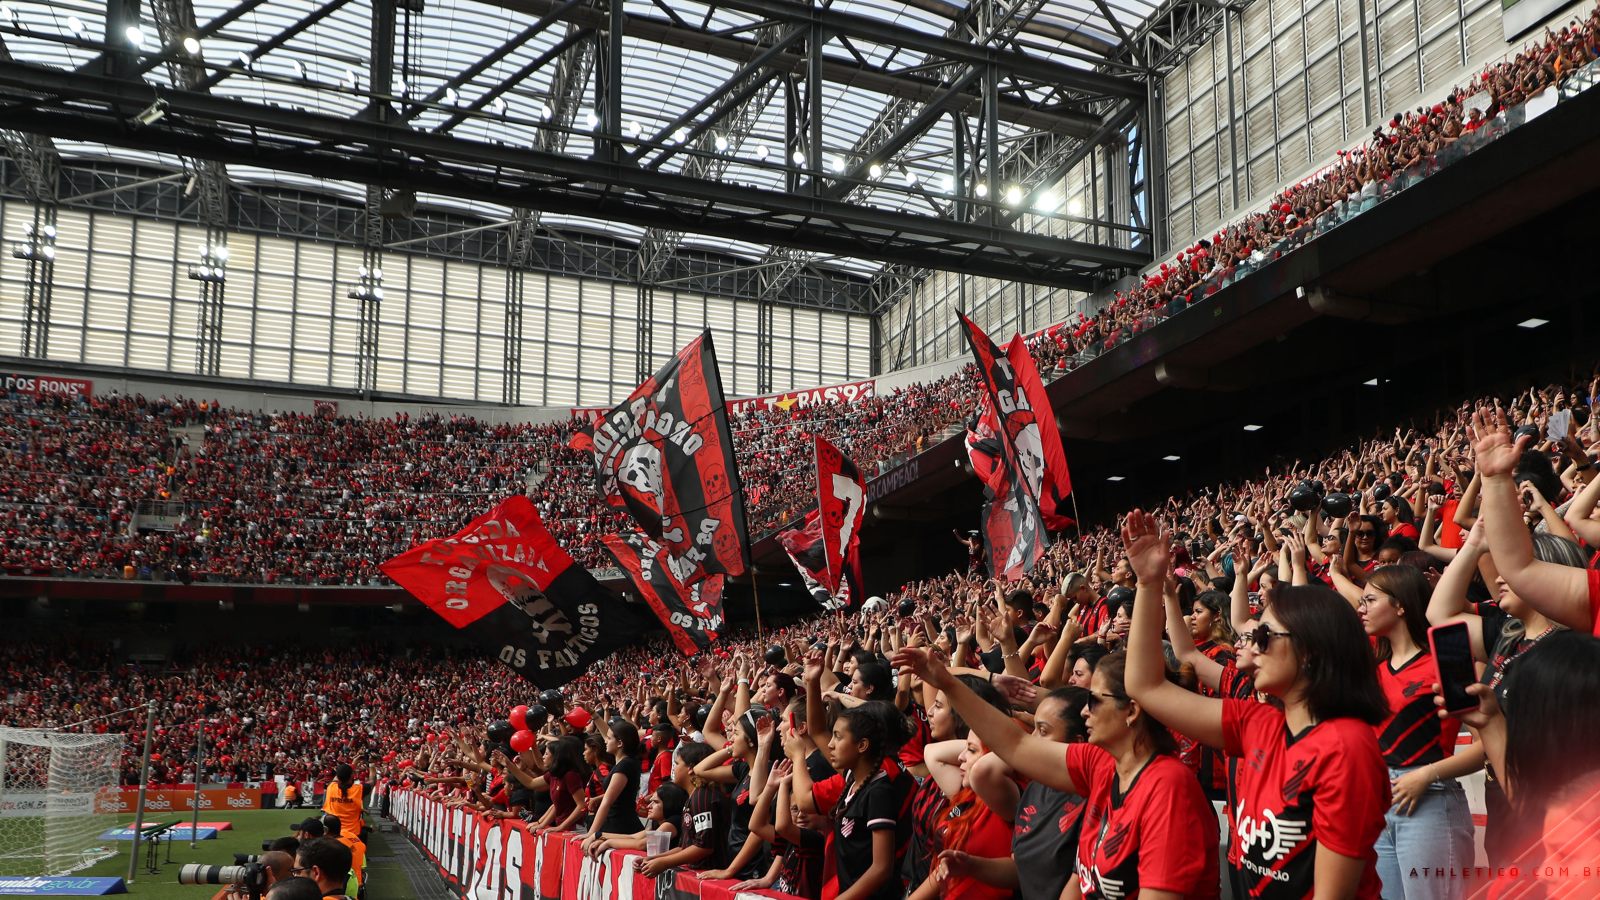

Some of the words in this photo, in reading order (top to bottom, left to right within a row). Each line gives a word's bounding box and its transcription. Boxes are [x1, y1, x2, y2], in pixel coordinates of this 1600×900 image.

[670, 611, 693, 628] OS
[499, 645, 527, 668] OS
[227, 796, 252, 807] ligga
[695, 813, 711, 825] HDI
